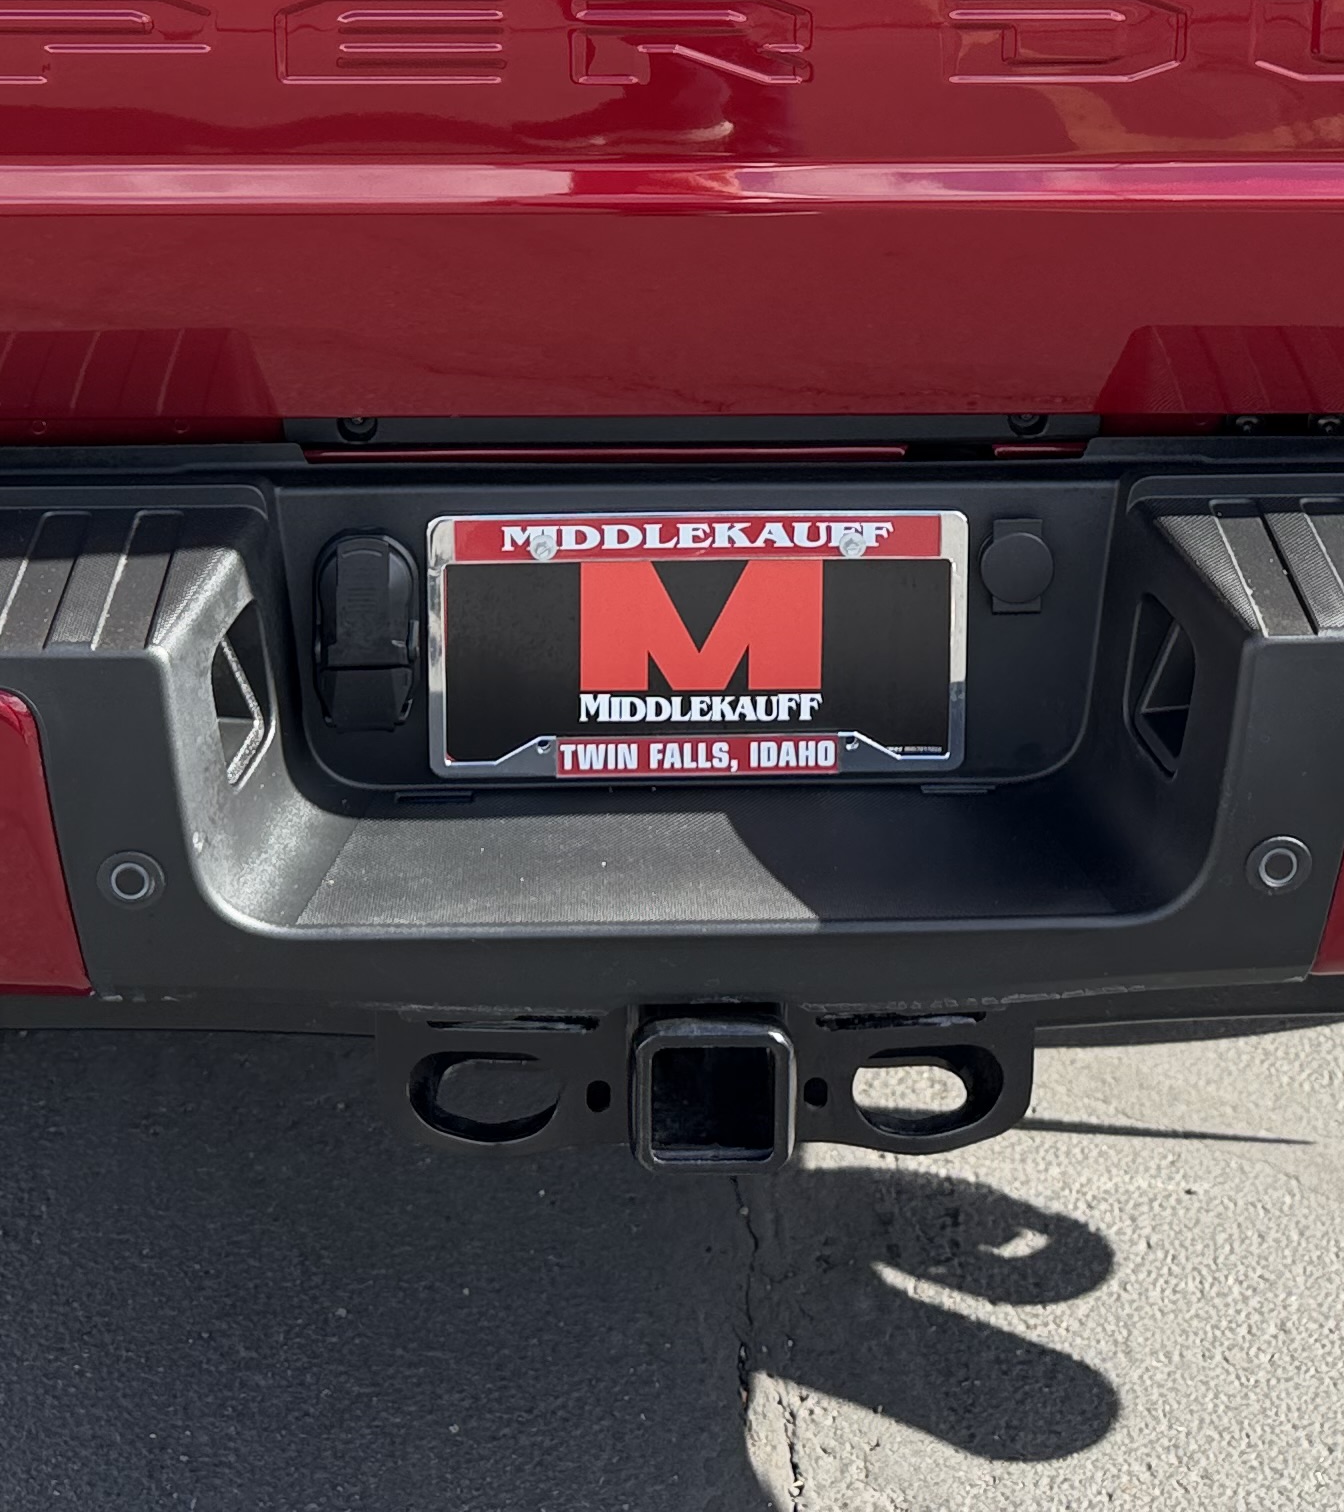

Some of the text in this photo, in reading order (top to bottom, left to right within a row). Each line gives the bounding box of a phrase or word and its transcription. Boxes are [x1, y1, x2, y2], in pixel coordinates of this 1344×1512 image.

[501, 521, 895, 552] MIDDLEKAUFF
[579, 558, 824, 692] M
[579, 693, 823, 723] MIDDLEKAUFF
[559, 740, 836, 773] TWIN FALLS, IDAHO
